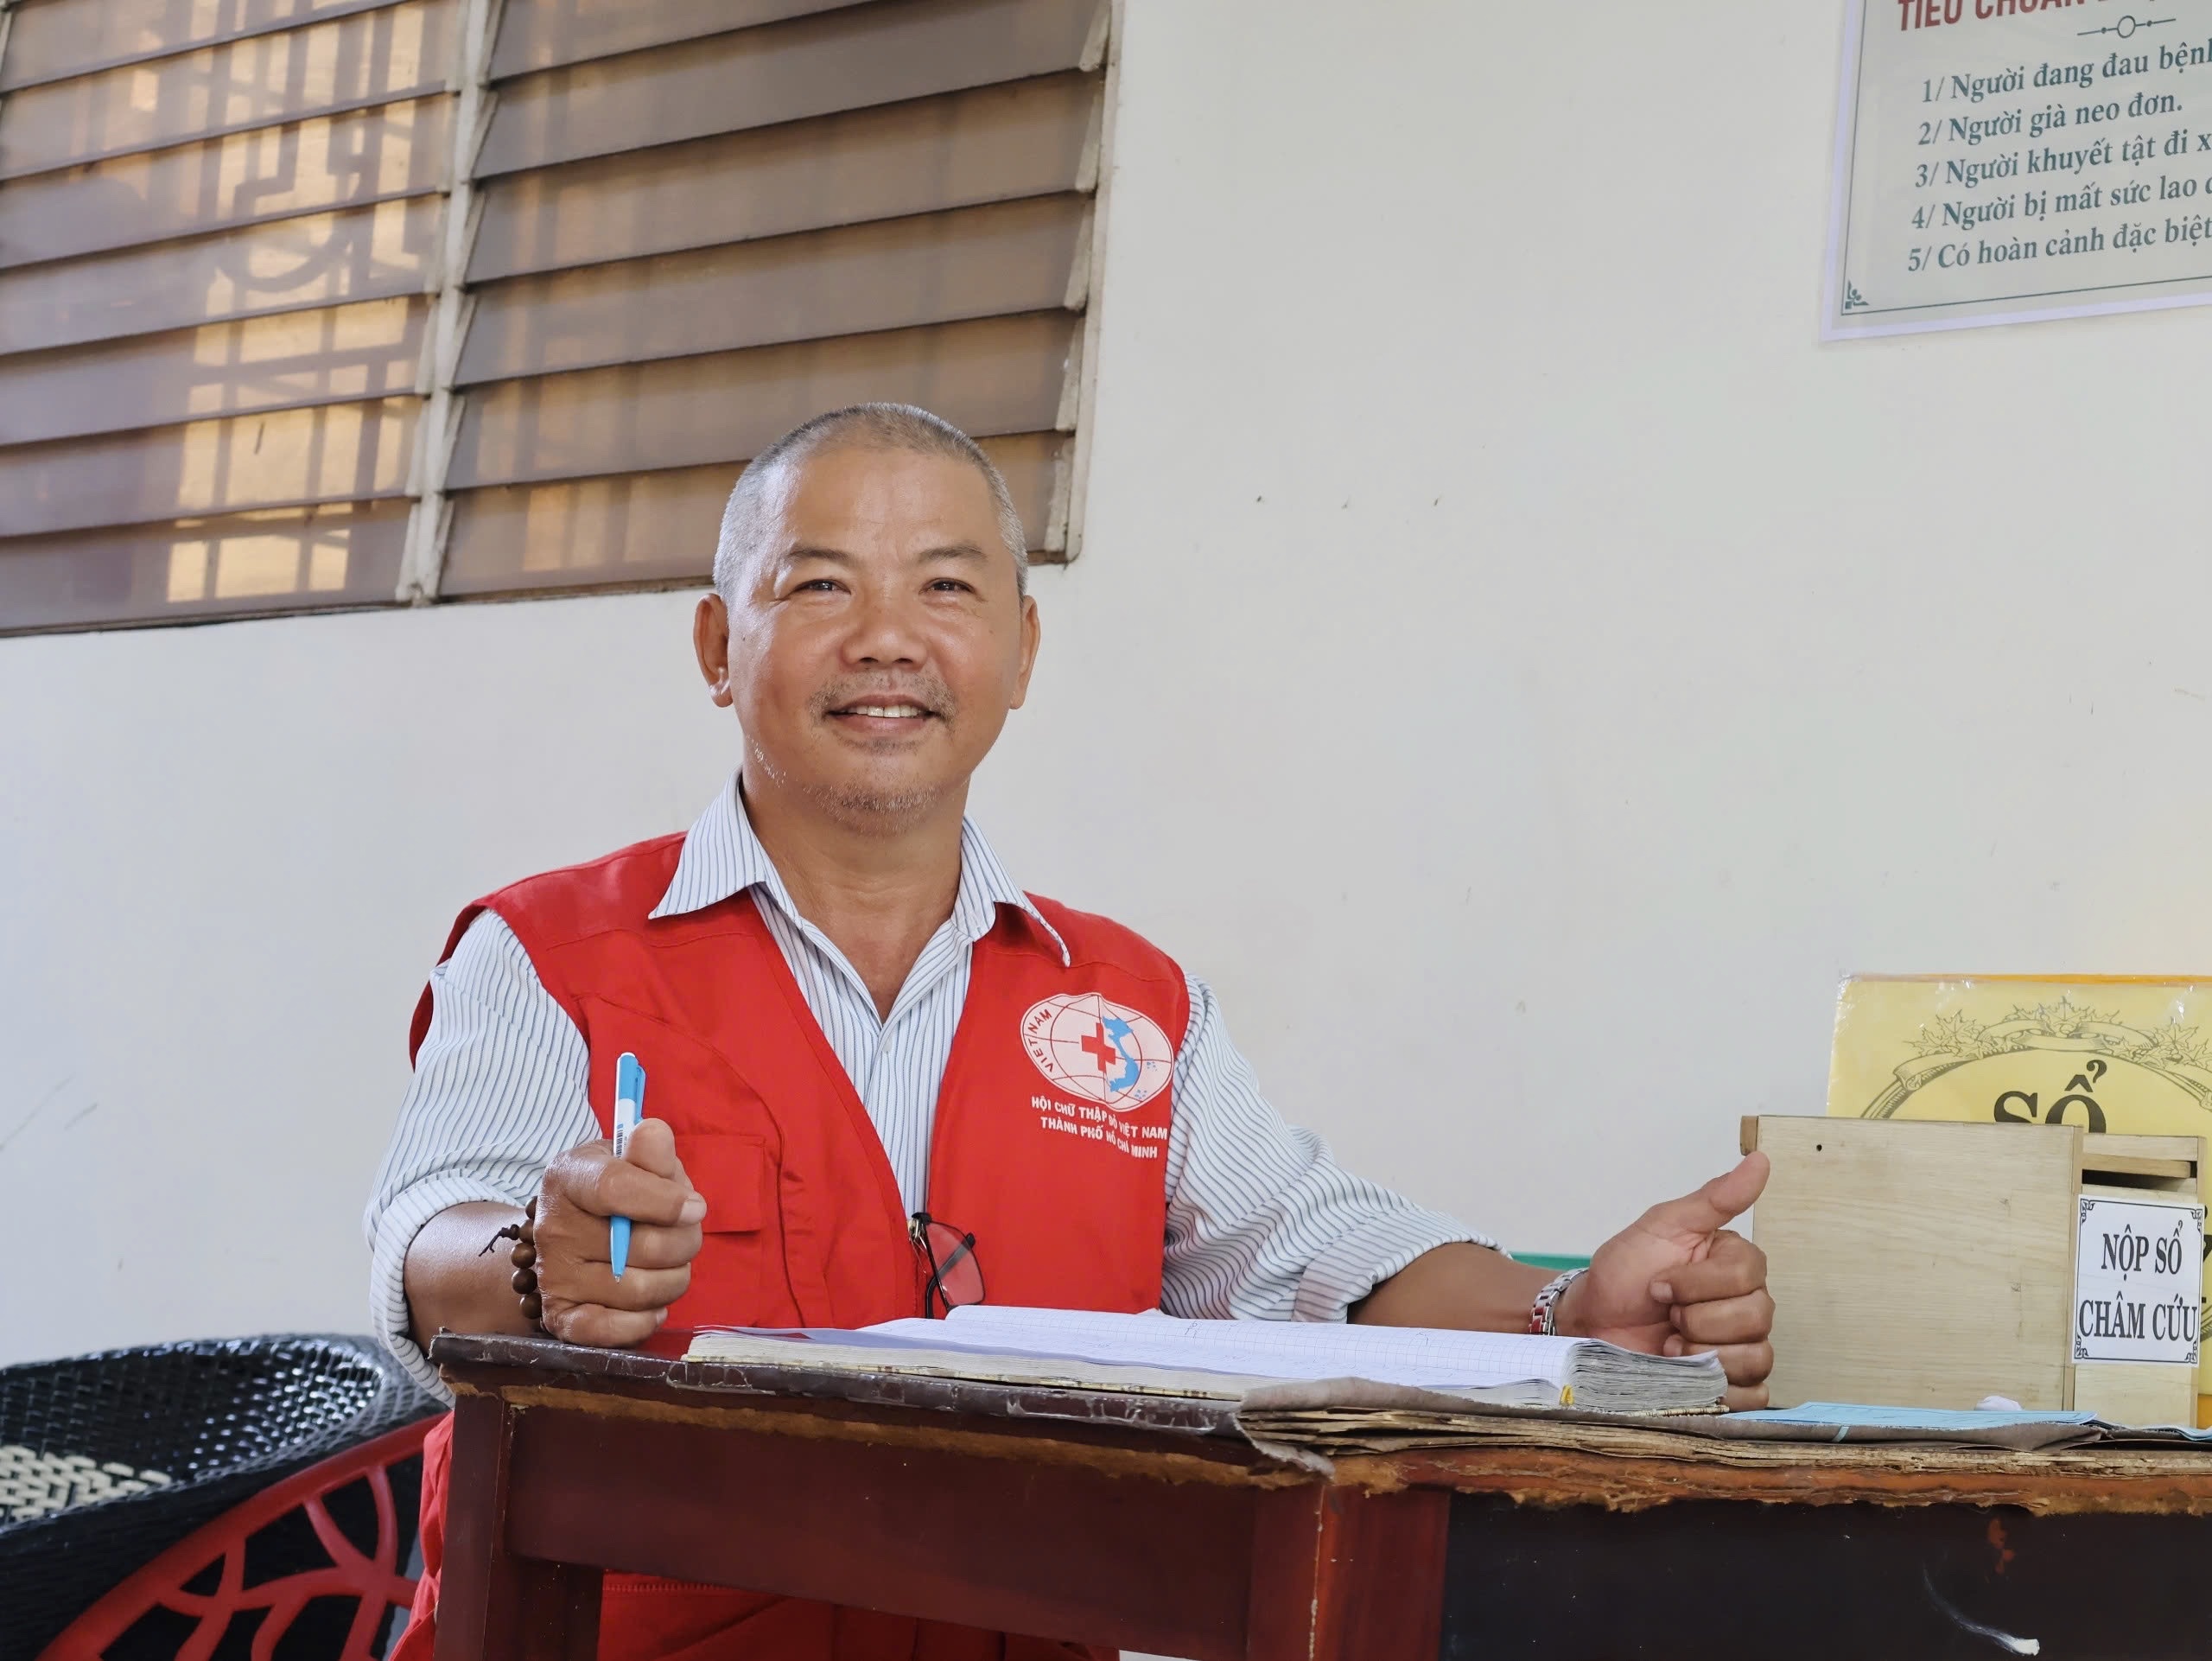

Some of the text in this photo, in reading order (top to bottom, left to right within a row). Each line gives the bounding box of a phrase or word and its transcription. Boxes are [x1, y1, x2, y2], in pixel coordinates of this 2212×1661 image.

[1923, 38, 2212, 104] 1/ Người đang đau bện
[1918, 92, 2183, 145] 2/ Người già neo đơn.
[1915, 162, 1939, 188] 3/
[1945, 152, 2018, 188] Người
[2027, 137, 2113, 175] khuyết
[2122, 134, 2156, 166] tật
[2164, 129, 2188, 156] đi
[1911, 204, 1936, 229] 4/
[1942, 194, 2015, 230] Người
[2024, 190, 2047, 221] bị
[2055, 181, 2103, 213] mất
[2110, 180, 2151, 206] sức
[2159, 175, 2197, 200] lao
[1908, 213, 2212, 271] 5/ Có hoàn cảnh đặc biệt
[1027, 1009, 1052, 1034] NAM
[1032, 1095, 1052, 1111] HỘI
[1055, 1103, 1076, 1117] CHỮ
[1078, 1106, 1107, 1123] THẬP
[1119, 1122, 1138, 1138] VIỆT
[1142, 1126, 1167, 1140] NAM
[1040, 1116, 1077, 1135] THÀNH
[1080, 1125, 1103, 1140] PHỐ
[1131, 1144, 1158, 1159] MINH
[2101, 1224, 2150, 1281] NỘP
[2155, 1219, 2183, 1275] SỔ
[2079, 1290, 2197, 1342] CHÂM CỨU
